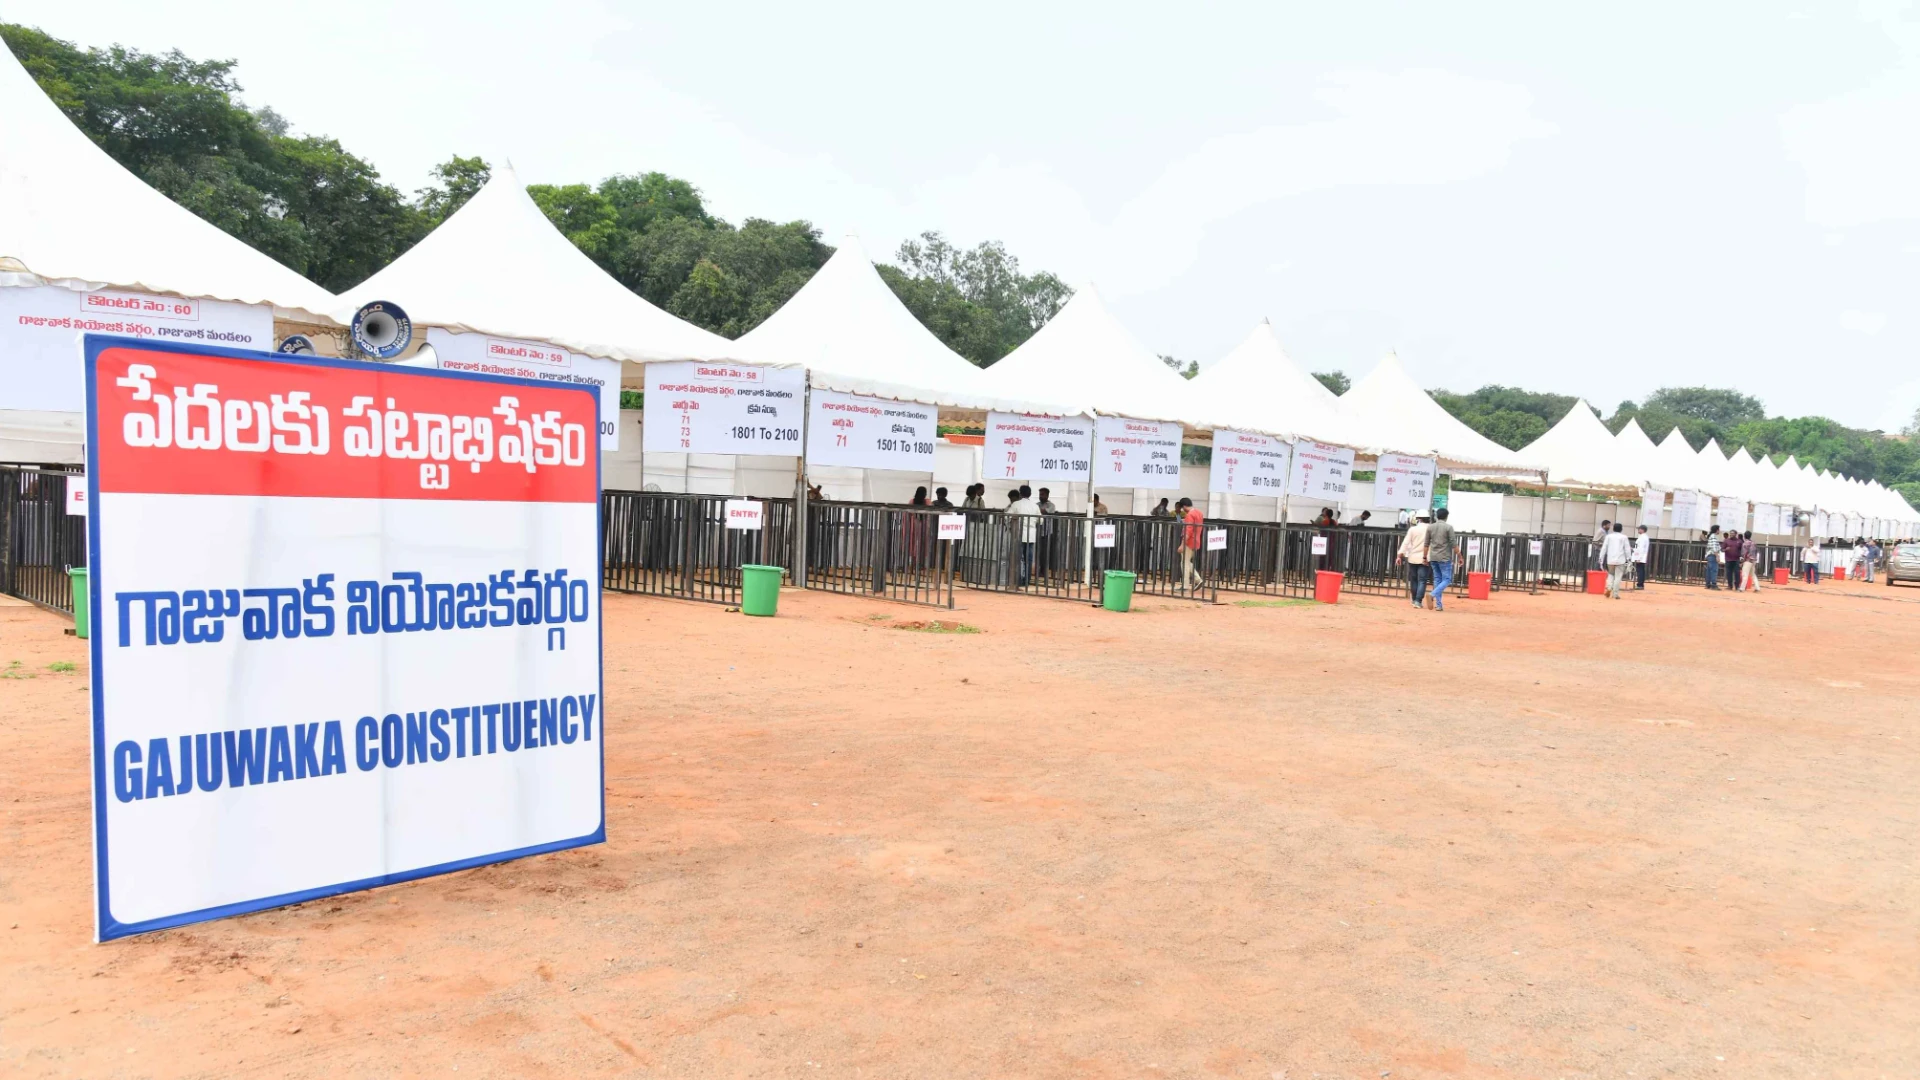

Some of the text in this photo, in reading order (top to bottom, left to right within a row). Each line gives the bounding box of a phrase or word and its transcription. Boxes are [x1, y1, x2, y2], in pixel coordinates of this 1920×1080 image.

[87, 294, 140, 310] కౌంటర్
[143, 300, 165, 312] నెం
[174, 304, 192, 315] 60
[18, 316, 72, 328] గాజువాక
[74, 319, 124, 332] నియోజక
[158, 327, 205, 339] గాజువాక
[206, 330, 252, 343] మండలం
[550, 354, 563, 362] 59
[443, 360, 480, 372] గాజువాక
[746, 372, 756, 380] 58
[682, 415, 690, 424] 71
[116, 363, 586, 490] పేదలకు పట్టాభిషేకం
[600, 421, 615, 436] 00
[681, 427, 691, 436] 73
[732, 426, 756, 439] 1801
[759, 427, 772, 440] To
[774, 428, 799, 442] 2100
[681, 439, 690, 448] 76
[836, 434, 848, 448] 71
[877, 438, 934, 454] 1501 To 1800
[1007, 452, 1017, 462] 70
[1040, 458, 1088, 471] 1201 To 1500
[1114, 462, 1122, 472] 70
[1142, 464, 1178, 475] 901 To 1200
[1006, 466, 1015, 477] 71
[1263, 477, 1270, 487] To
[730, 509, 759, 519] ENTRY
[941, 524, 964, 532] ENTRY
[116, 568, 590, 651] గాజువాక నియోజకవర్గం
[113, 693, 597, 804] GAJUWAKA CONSTITUENCY
